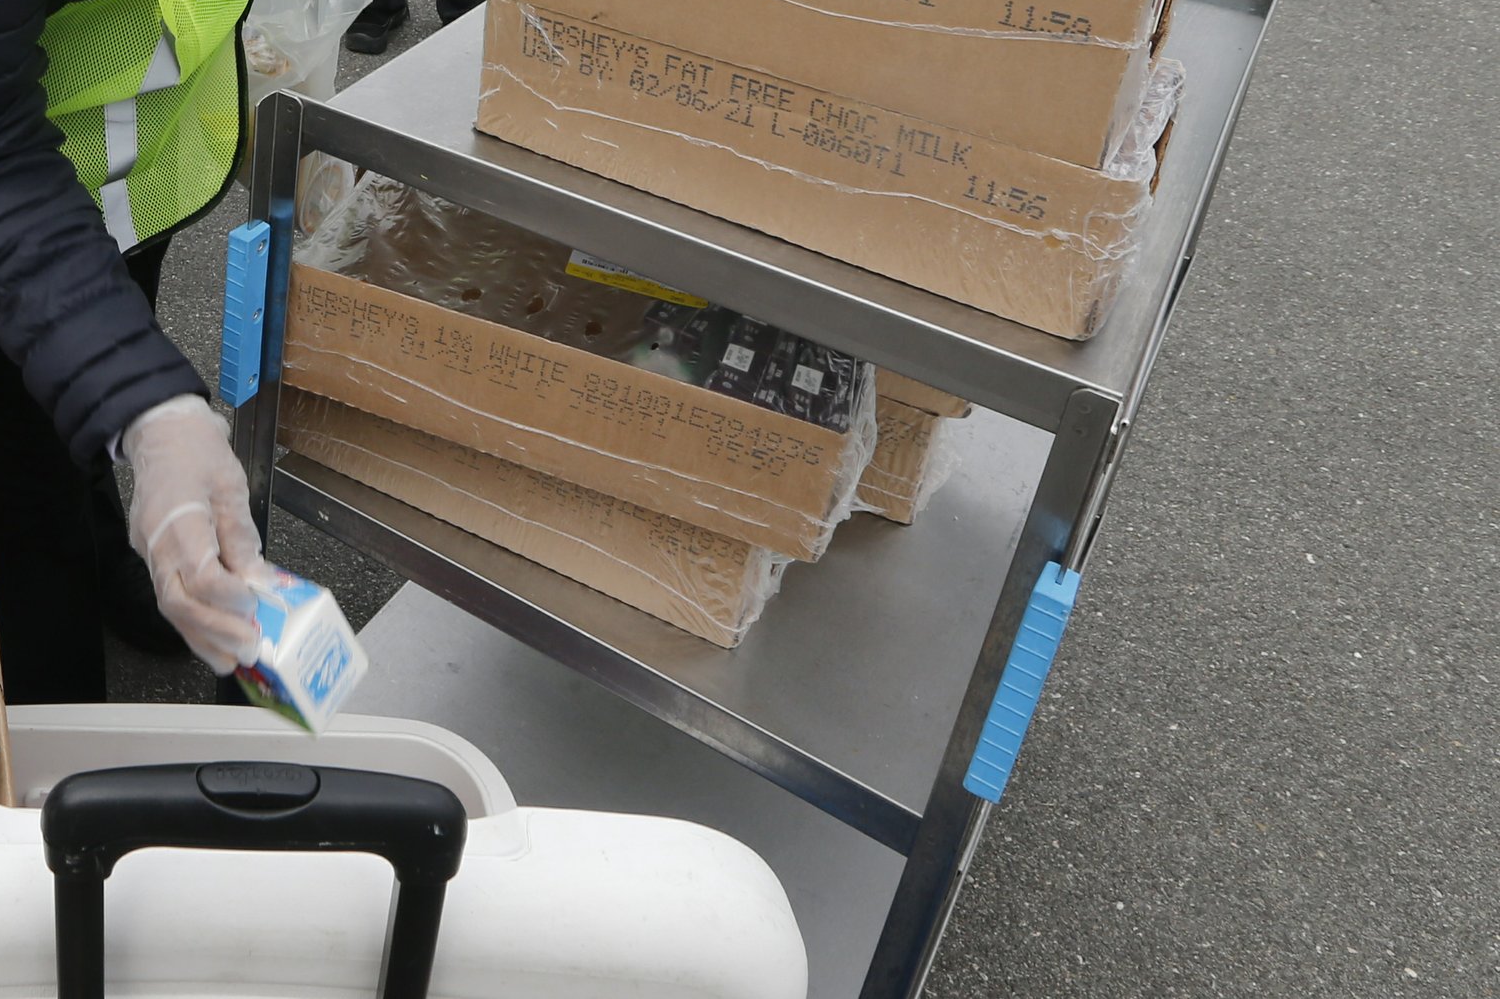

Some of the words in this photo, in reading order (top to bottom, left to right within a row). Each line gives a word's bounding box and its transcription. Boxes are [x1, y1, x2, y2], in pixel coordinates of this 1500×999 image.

[524, 15, 649, 68] HERSHEY'S
[665, 54, 713, 87] FAT
[731, 73, 795, 112] FREE
[810, 98, 878, 139] CHOC
[897, 125, 972, 169] MILK
